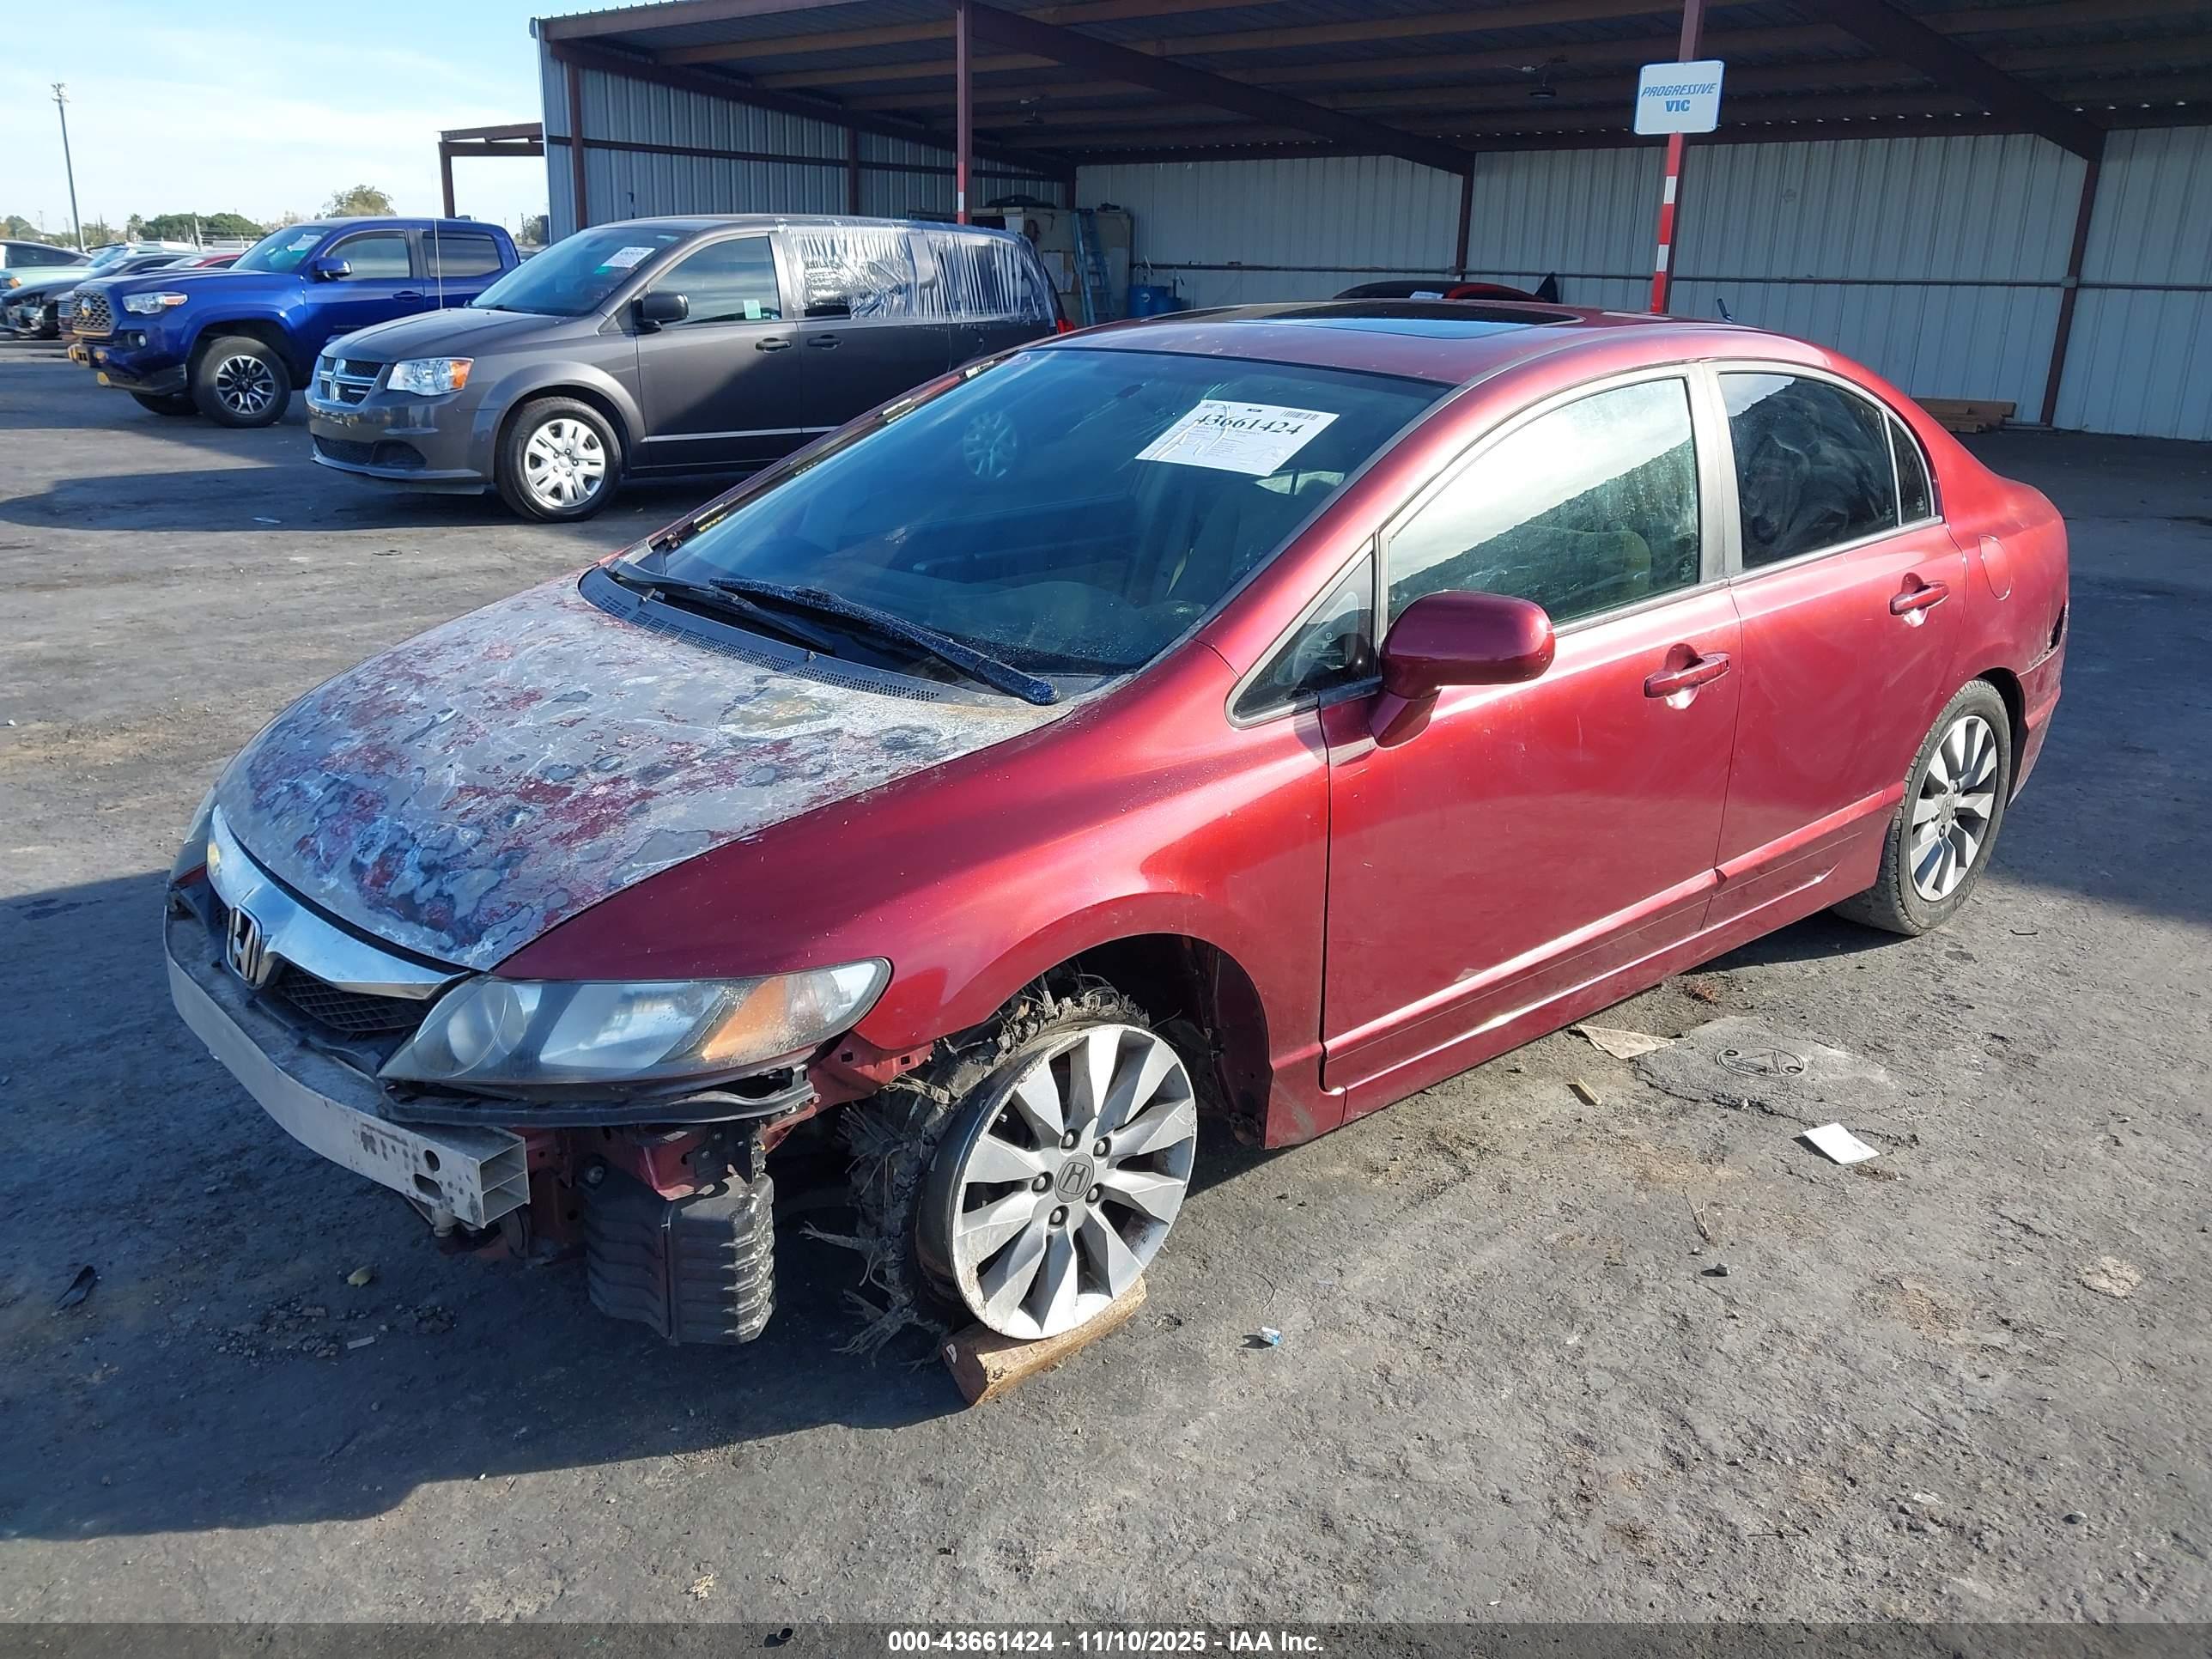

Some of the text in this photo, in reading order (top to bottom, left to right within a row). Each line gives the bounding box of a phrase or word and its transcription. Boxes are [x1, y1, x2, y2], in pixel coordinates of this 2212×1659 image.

[1642, 83, 1717, 97] PROGRESSIVE
[1665, 100, 1691, 112] VIC
[1197, 413, 1304, 436] 43661424
